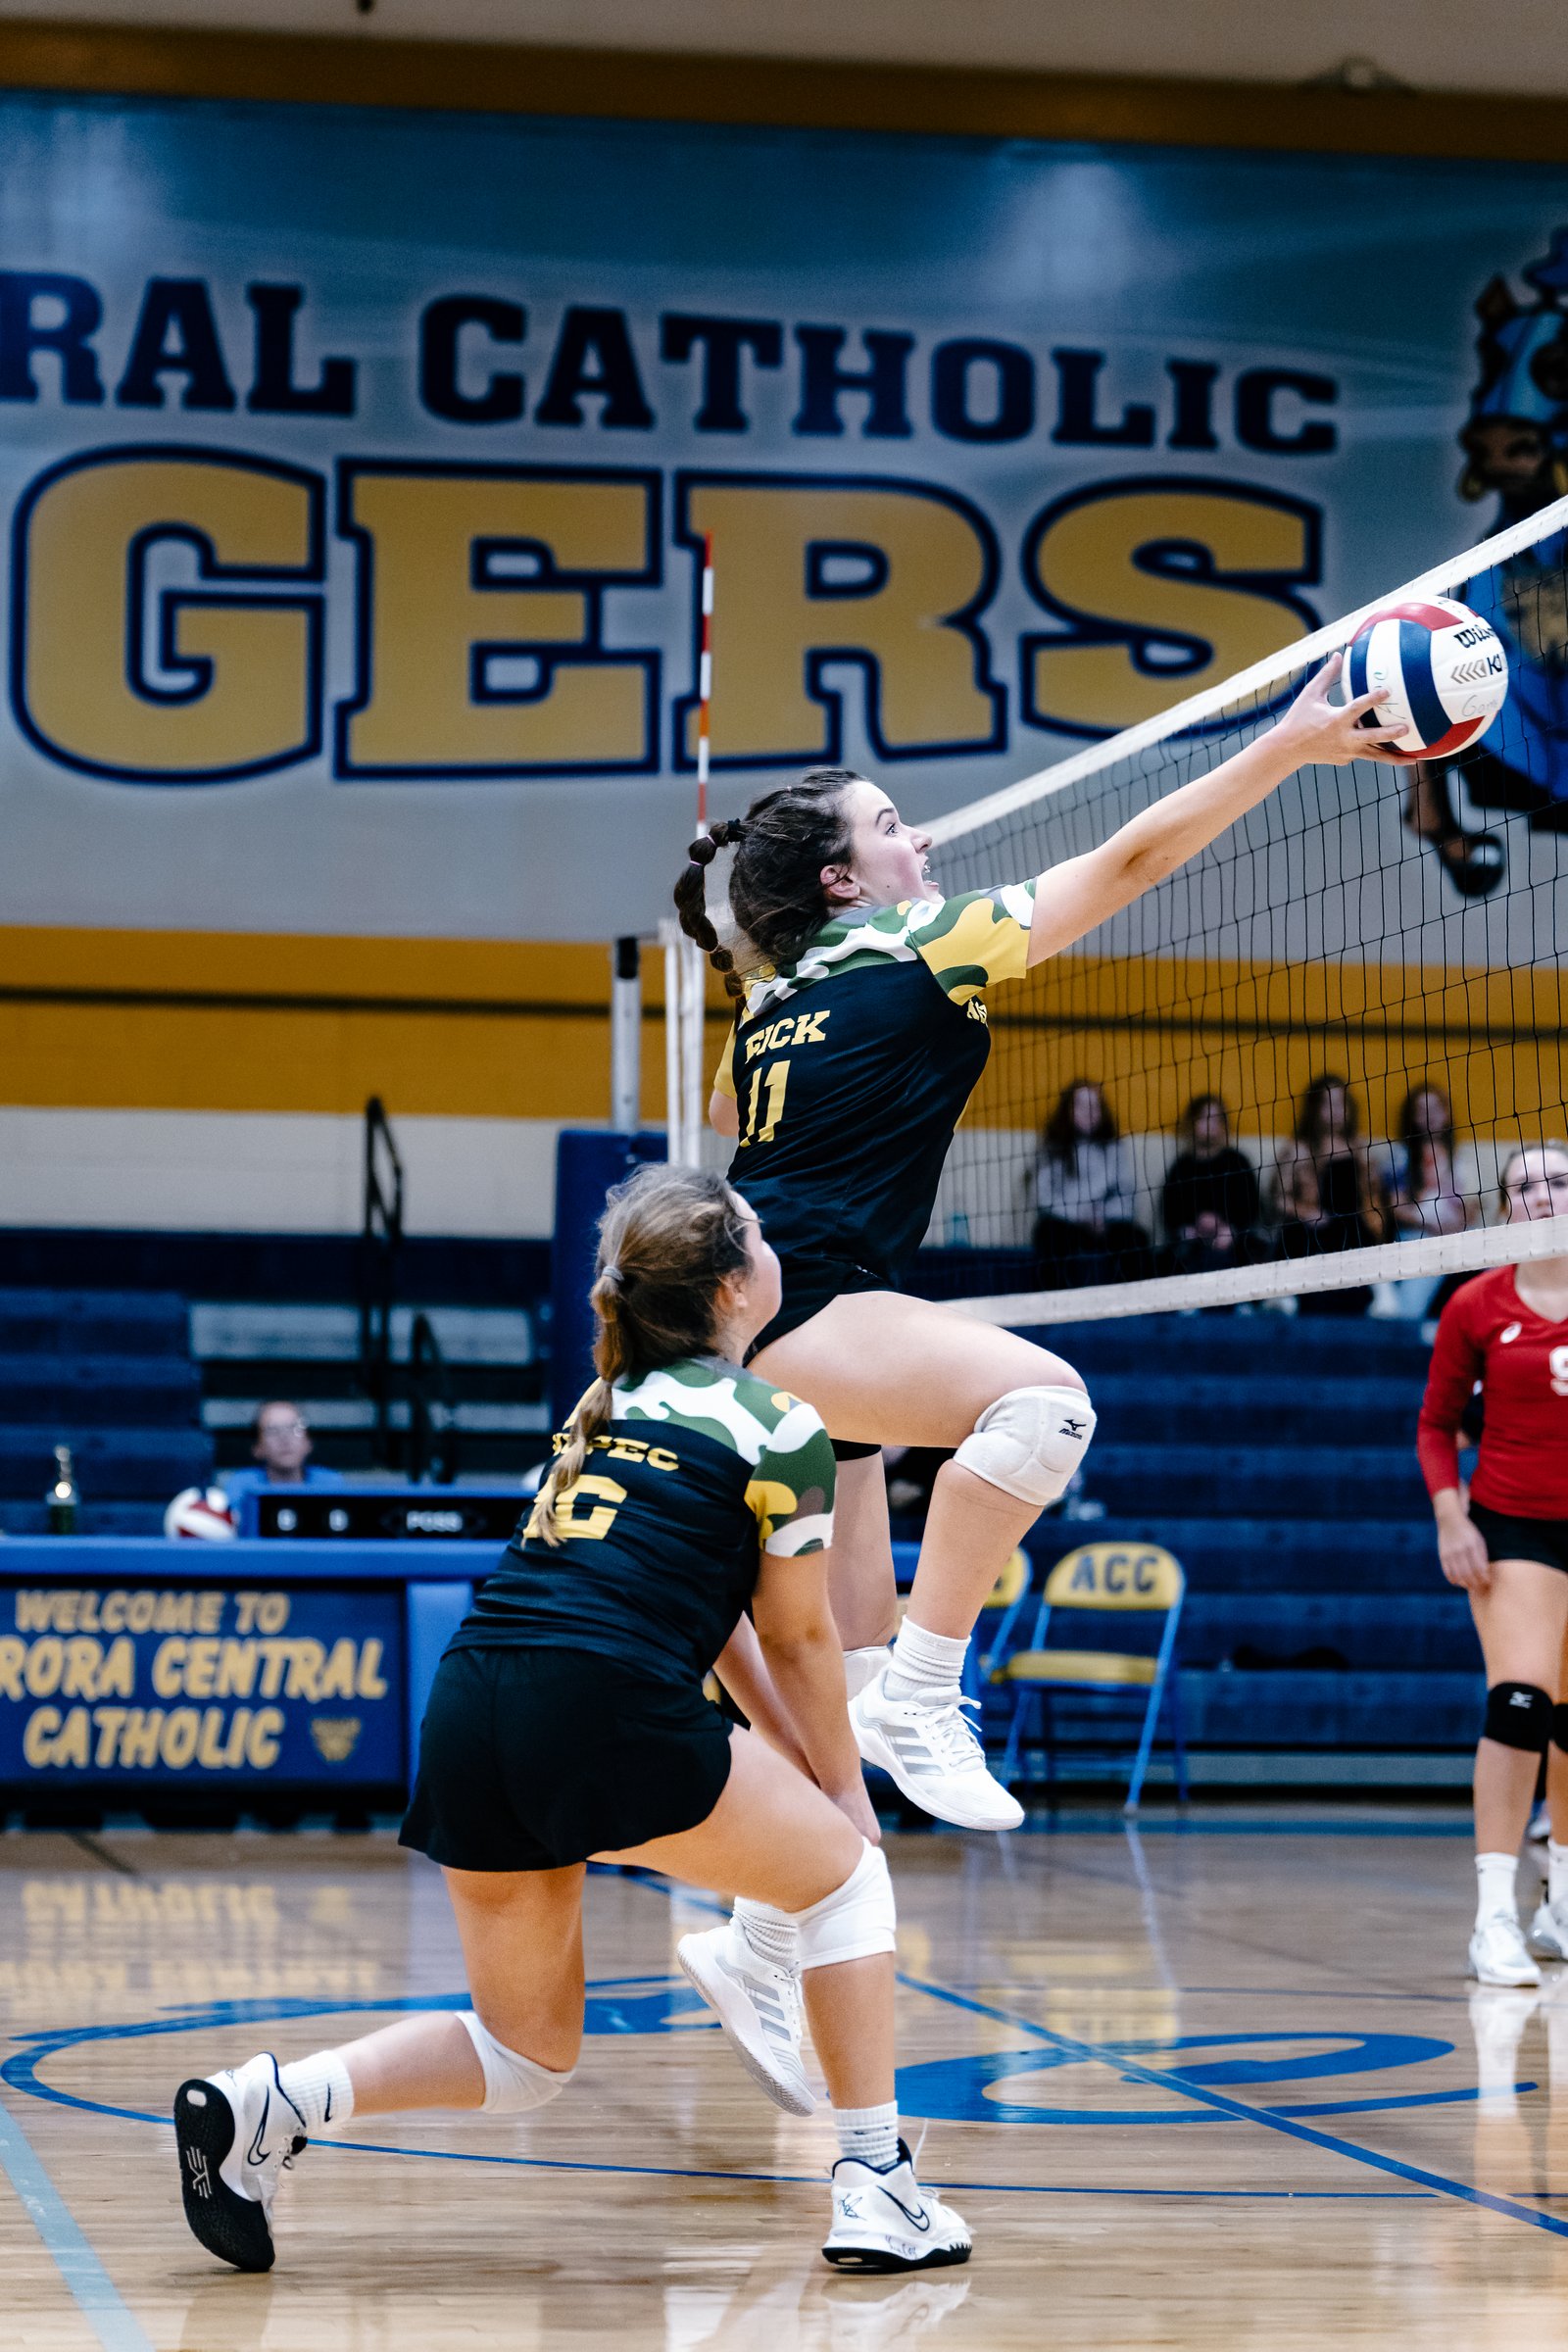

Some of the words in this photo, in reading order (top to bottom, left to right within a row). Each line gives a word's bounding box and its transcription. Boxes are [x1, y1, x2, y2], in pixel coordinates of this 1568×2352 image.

[0, 270, 356, 417] RAL
[419, 293, 1338, 455] CATHOLIC
[10, 442, 1324, 785] GERS
[745, 1010, 830, 1064] FICK
[739, 1059, 791, 1148] 11
[1070, 1553, 1159, 1594] ACC
[15, 1591, 226, 1634] WELCOME
[235, 1592, 291, 1635] TO
[0, 1635, 135, 1702] RORA
[152, 1638, 387, 1702] CENTRAL
[23, 1706, 285, 1769] CATHOLIC
